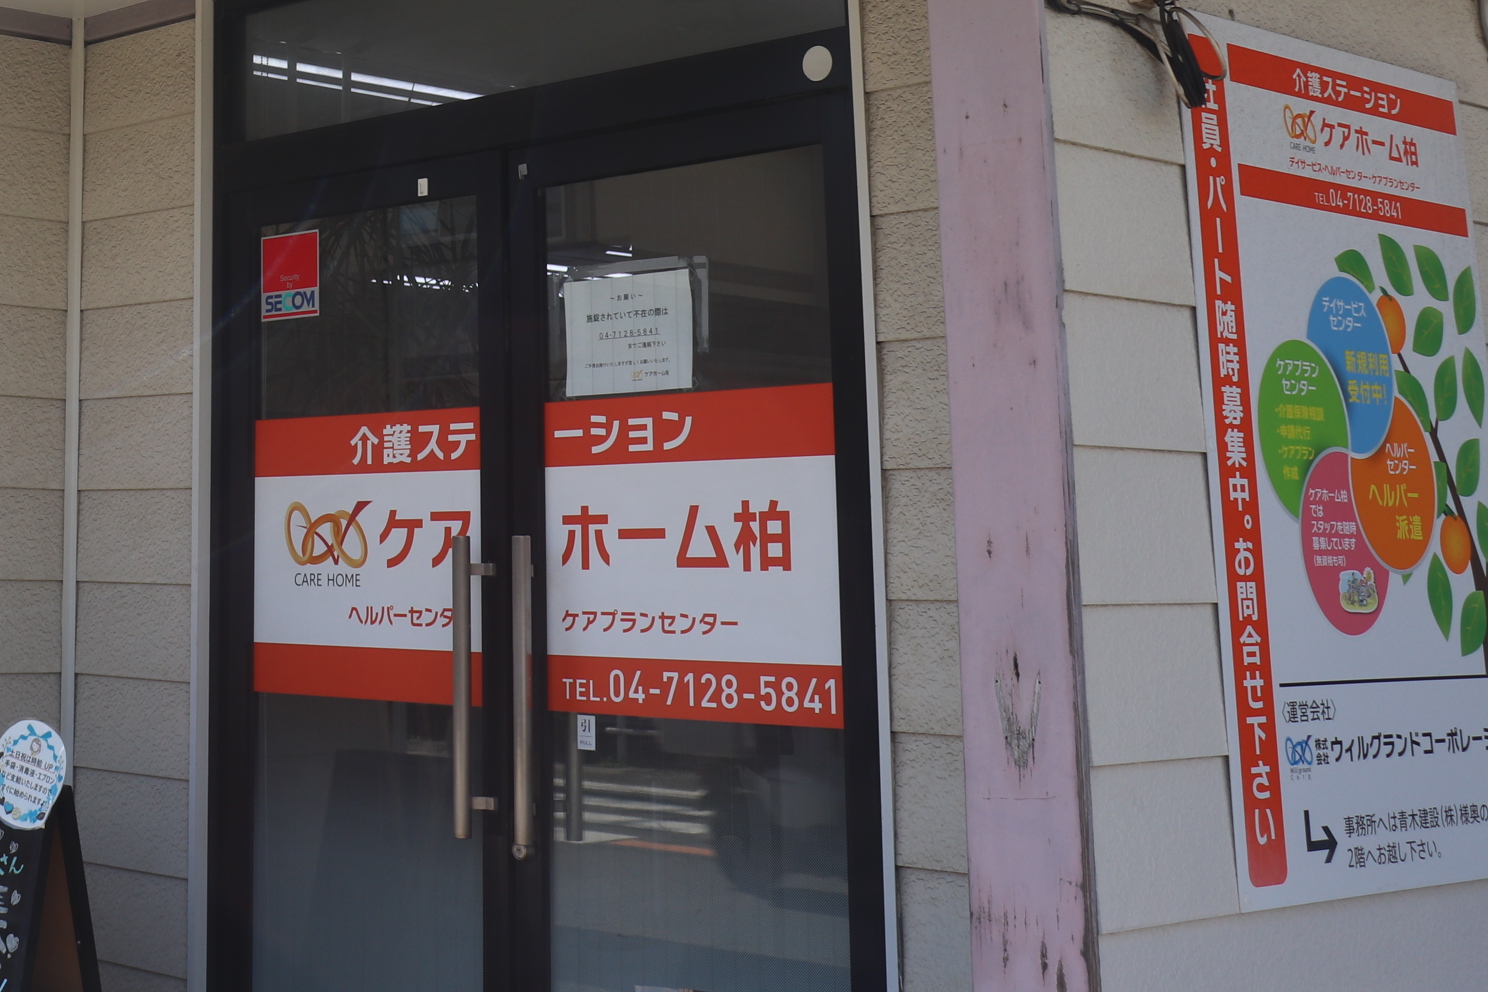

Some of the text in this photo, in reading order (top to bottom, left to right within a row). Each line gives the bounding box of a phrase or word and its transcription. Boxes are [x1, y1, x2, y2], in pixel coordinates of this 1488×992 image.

[1292, 67, 1401, 115] 介護ステーション
[1289, 142, 1316, 154] CARE HOME
[1320, 117, 1420, 168] ケアホーム柏
[280, 273, 300, 282] Security
[286, 281, 293, 289] by
[265, 290, 315, 313] SECOM
[1321, 297, 1367, 317] デイサービス
[1329, 315, 1362, 332] センター
[1276, 358, 1319, 378] ケアプラン
[1344, 350, 1390, 377] 新規利用
[1281, 378, 1317, 396] センター
[350, 411, 693, 465] 介護ステ ーション
[1385, 442, 1415, 458] ヘルパー
[1283, 465, 1299, 481] 作成
[1386, 459, 1417, 475] センター
[1308, 488, 1348, 503] ケアホーム柏
[1369, 483, 1419, 507] ヘルパー
[1309, 505, 1324, 518] では
[1311, 521, 1357, 535] スタッフを随時
[1396, 514, 1423, 540] 派遣
[379, 499, 792, 572] ケア ホーム柏
[1312, 537, 1356, 550] 募集しています
[294, 573, 361, 587] CARE HOME
[348, 605, 454, 628] ヘルパーセンタ
[561, 609, 738, 635] ケアプランセンター
[580, 719, 591, 733] 引
[1315, 737, 1329, 751] 株式
[1315, 751, 1330, 766] 会社
